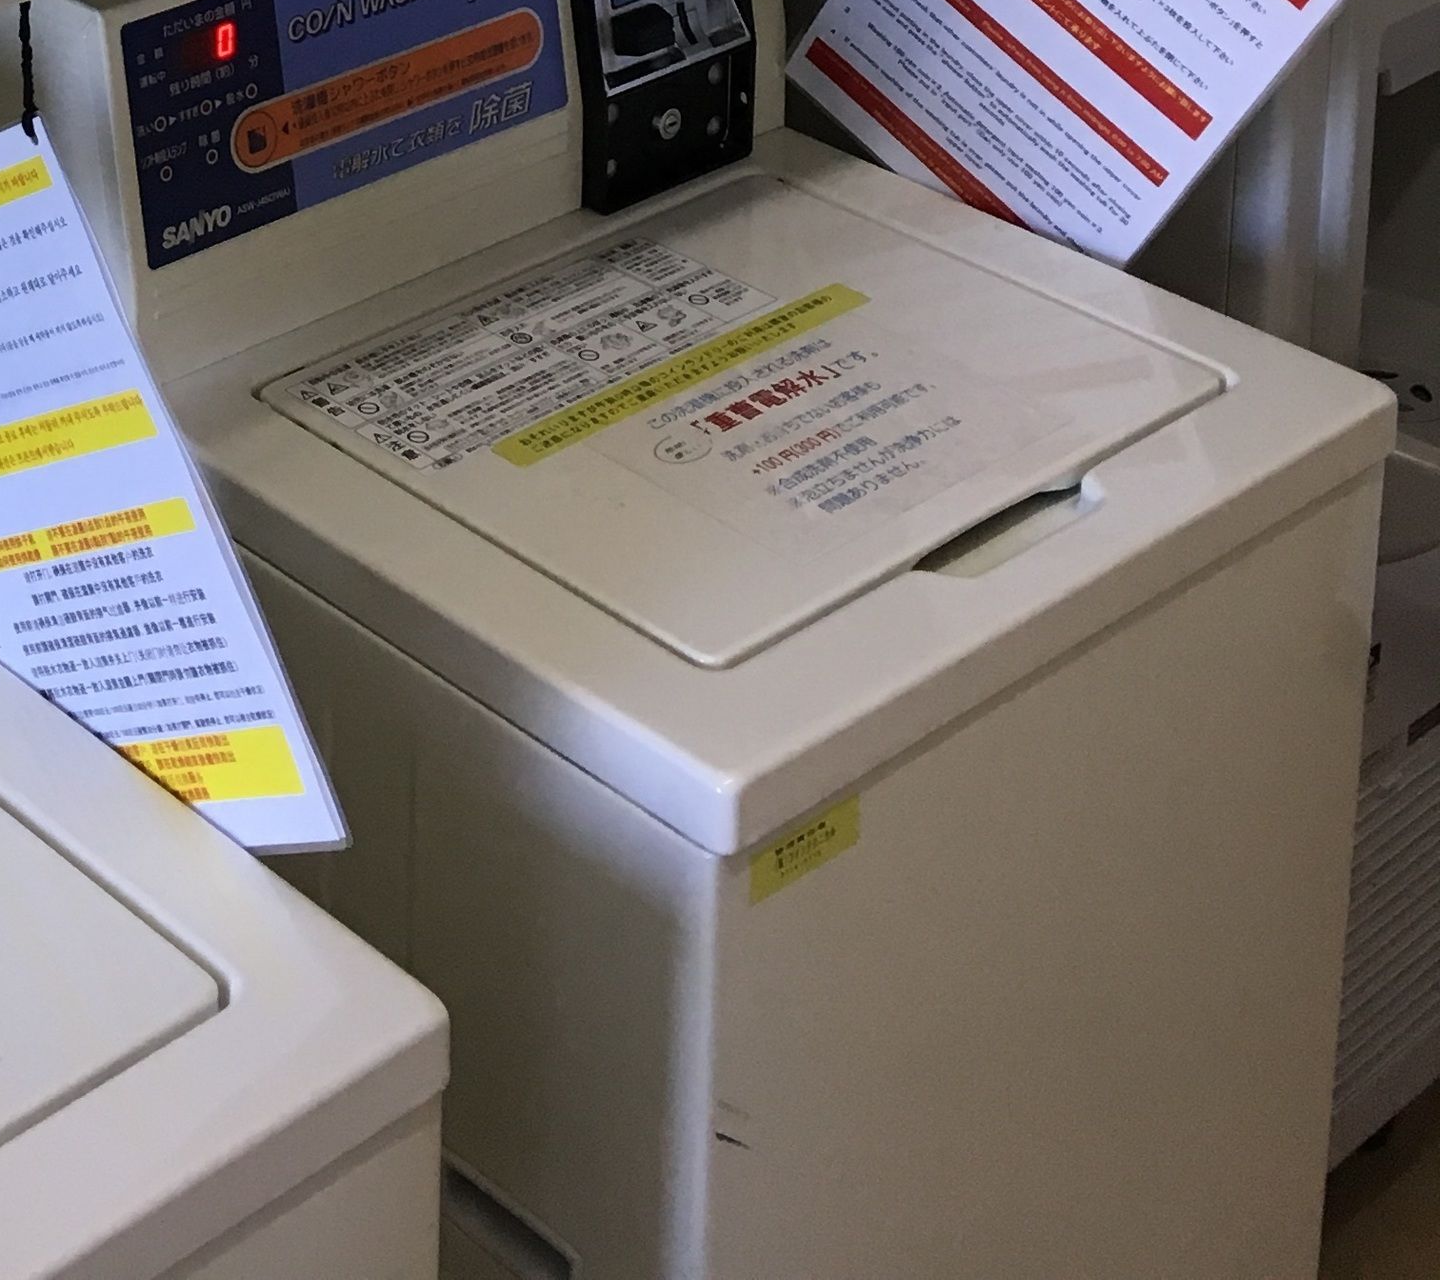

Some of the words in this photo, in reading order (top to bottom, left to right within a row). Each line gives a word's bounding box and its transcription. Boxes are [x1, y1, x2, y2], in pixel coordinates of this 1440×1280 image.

[216, 22, 235, 59] 0
[469, 81, 533, 135] 除菌
[1063, 131, 1089, 155] opening
[162, 204, 233, 250] SANYO
